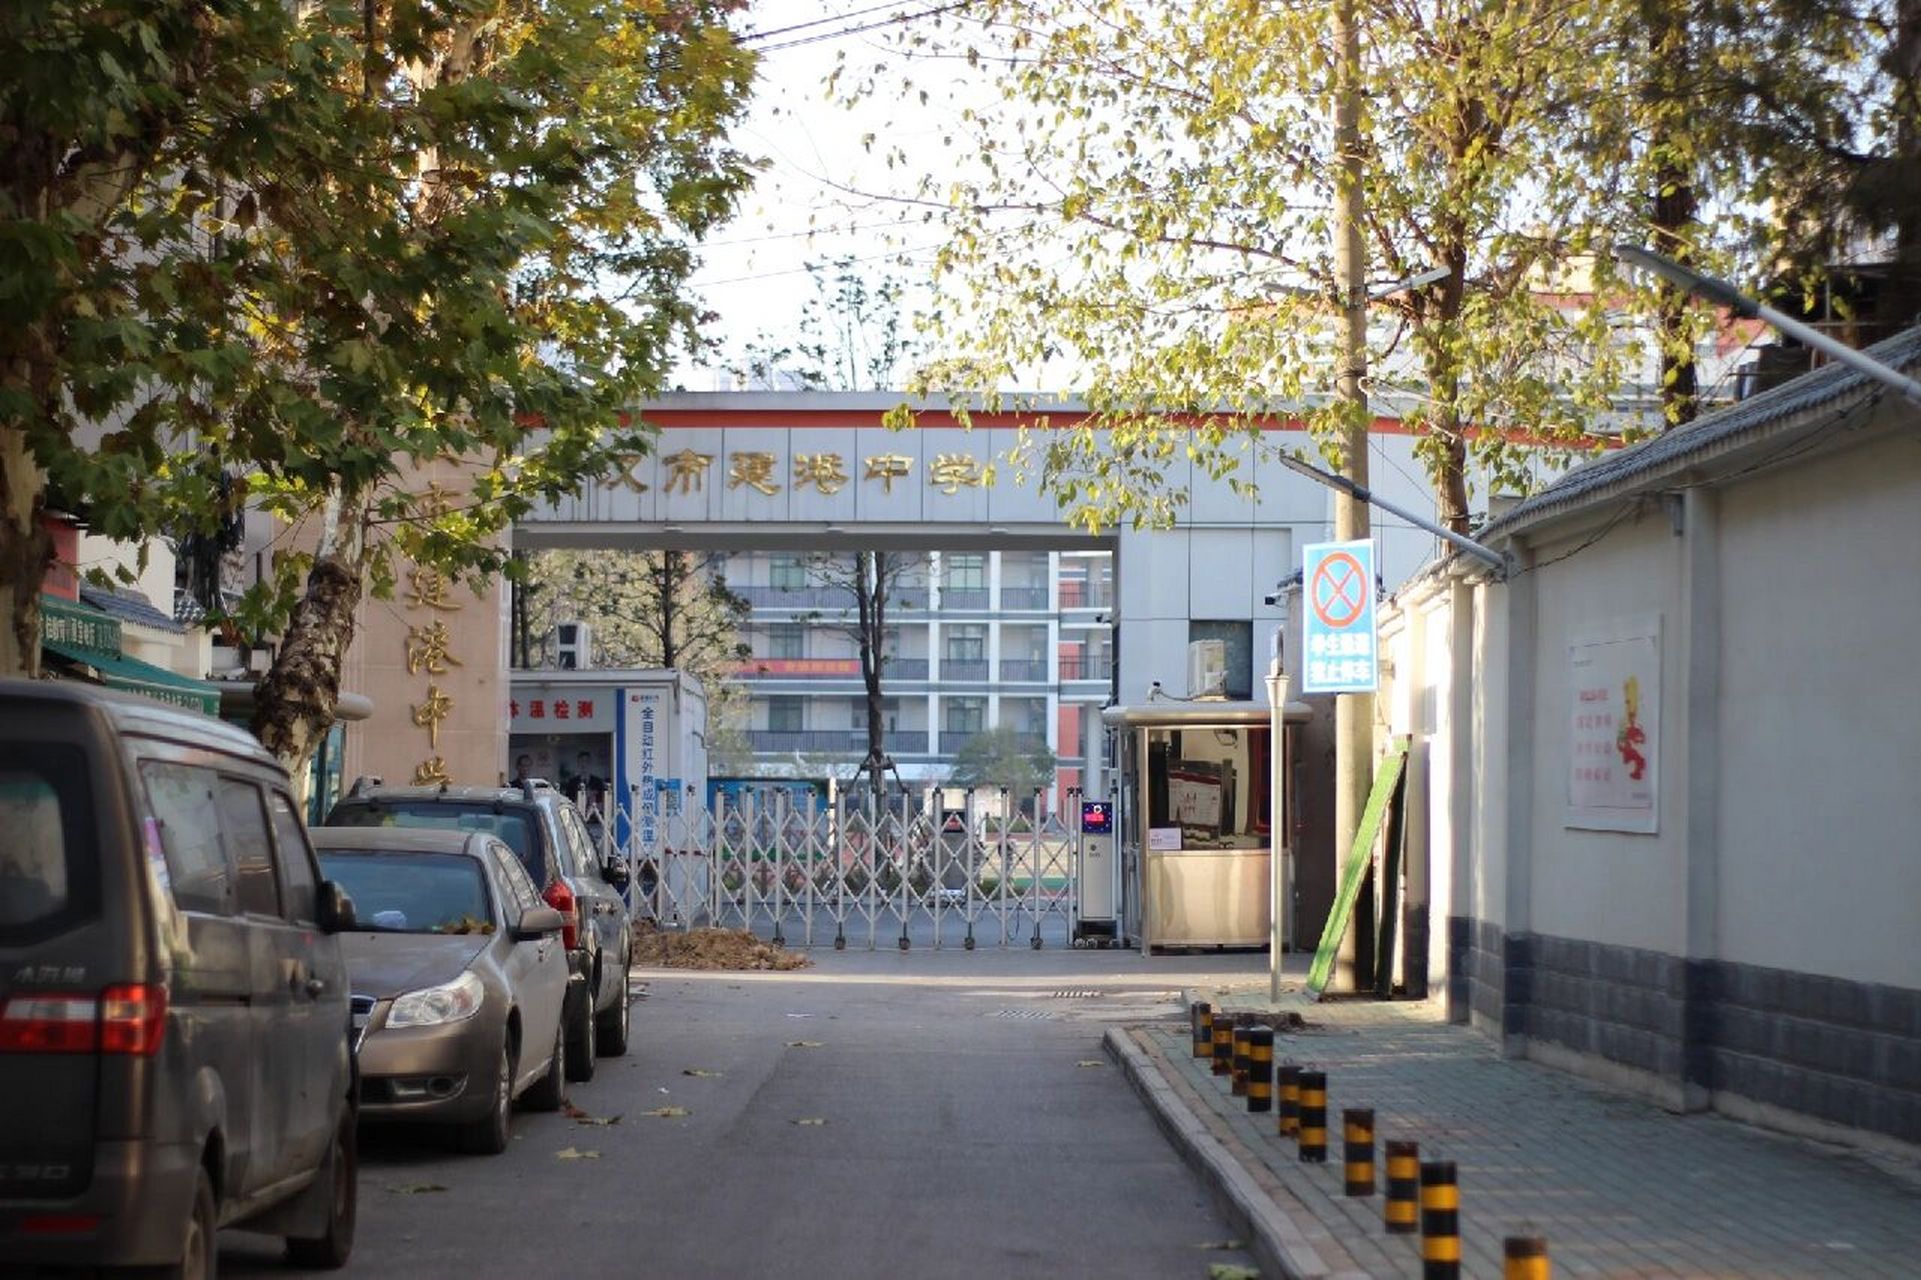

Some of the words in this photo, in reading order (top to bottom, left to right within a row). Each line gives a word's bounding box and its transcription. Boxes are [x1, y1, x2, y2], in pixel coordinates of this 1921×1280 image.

[594, 447, 979, 496] 汉市建港中学
